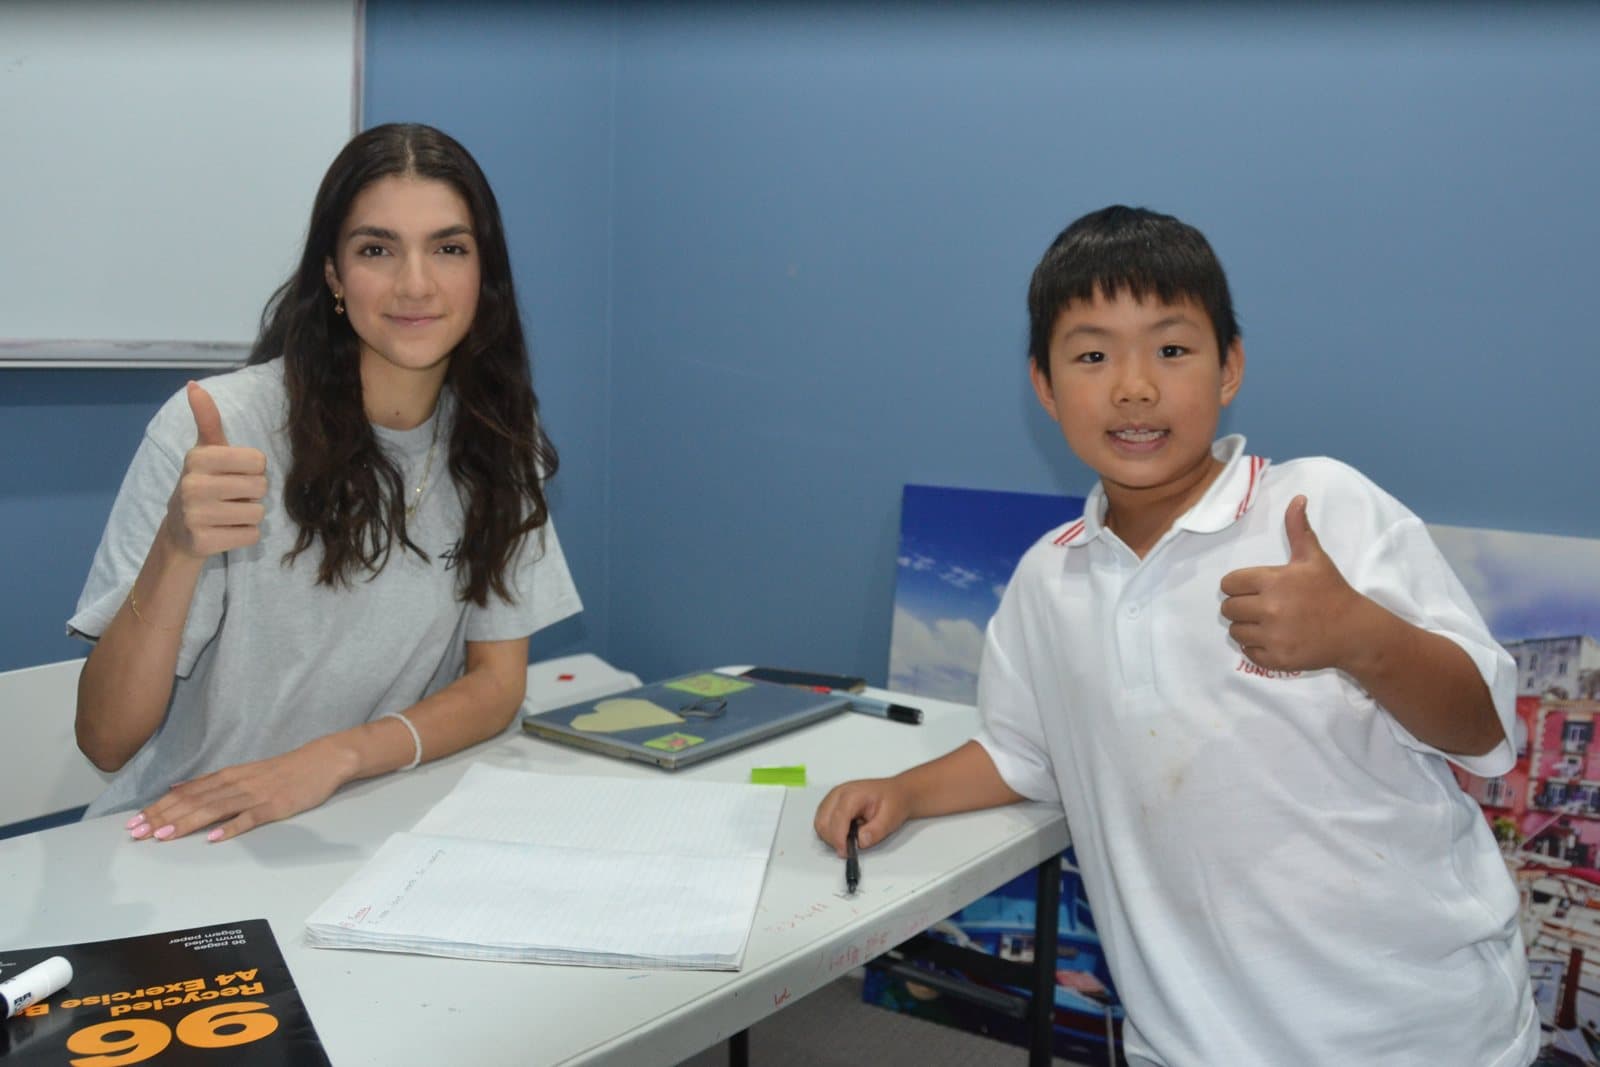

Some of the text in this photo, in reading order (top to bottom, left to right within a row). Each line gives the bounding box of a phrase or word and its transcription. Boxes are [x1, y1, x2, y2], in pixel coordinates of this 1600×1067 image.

[168, 934, 202, 945] paper
[184, 934, 244, 948] 8mm ruled
[193, 941, 229, 951] pages
[18, 968, 259, 1017] A4 Exercise B
[109, 981, 265, 1017] Recycled
[66, 1001, 279, 1067] 96
